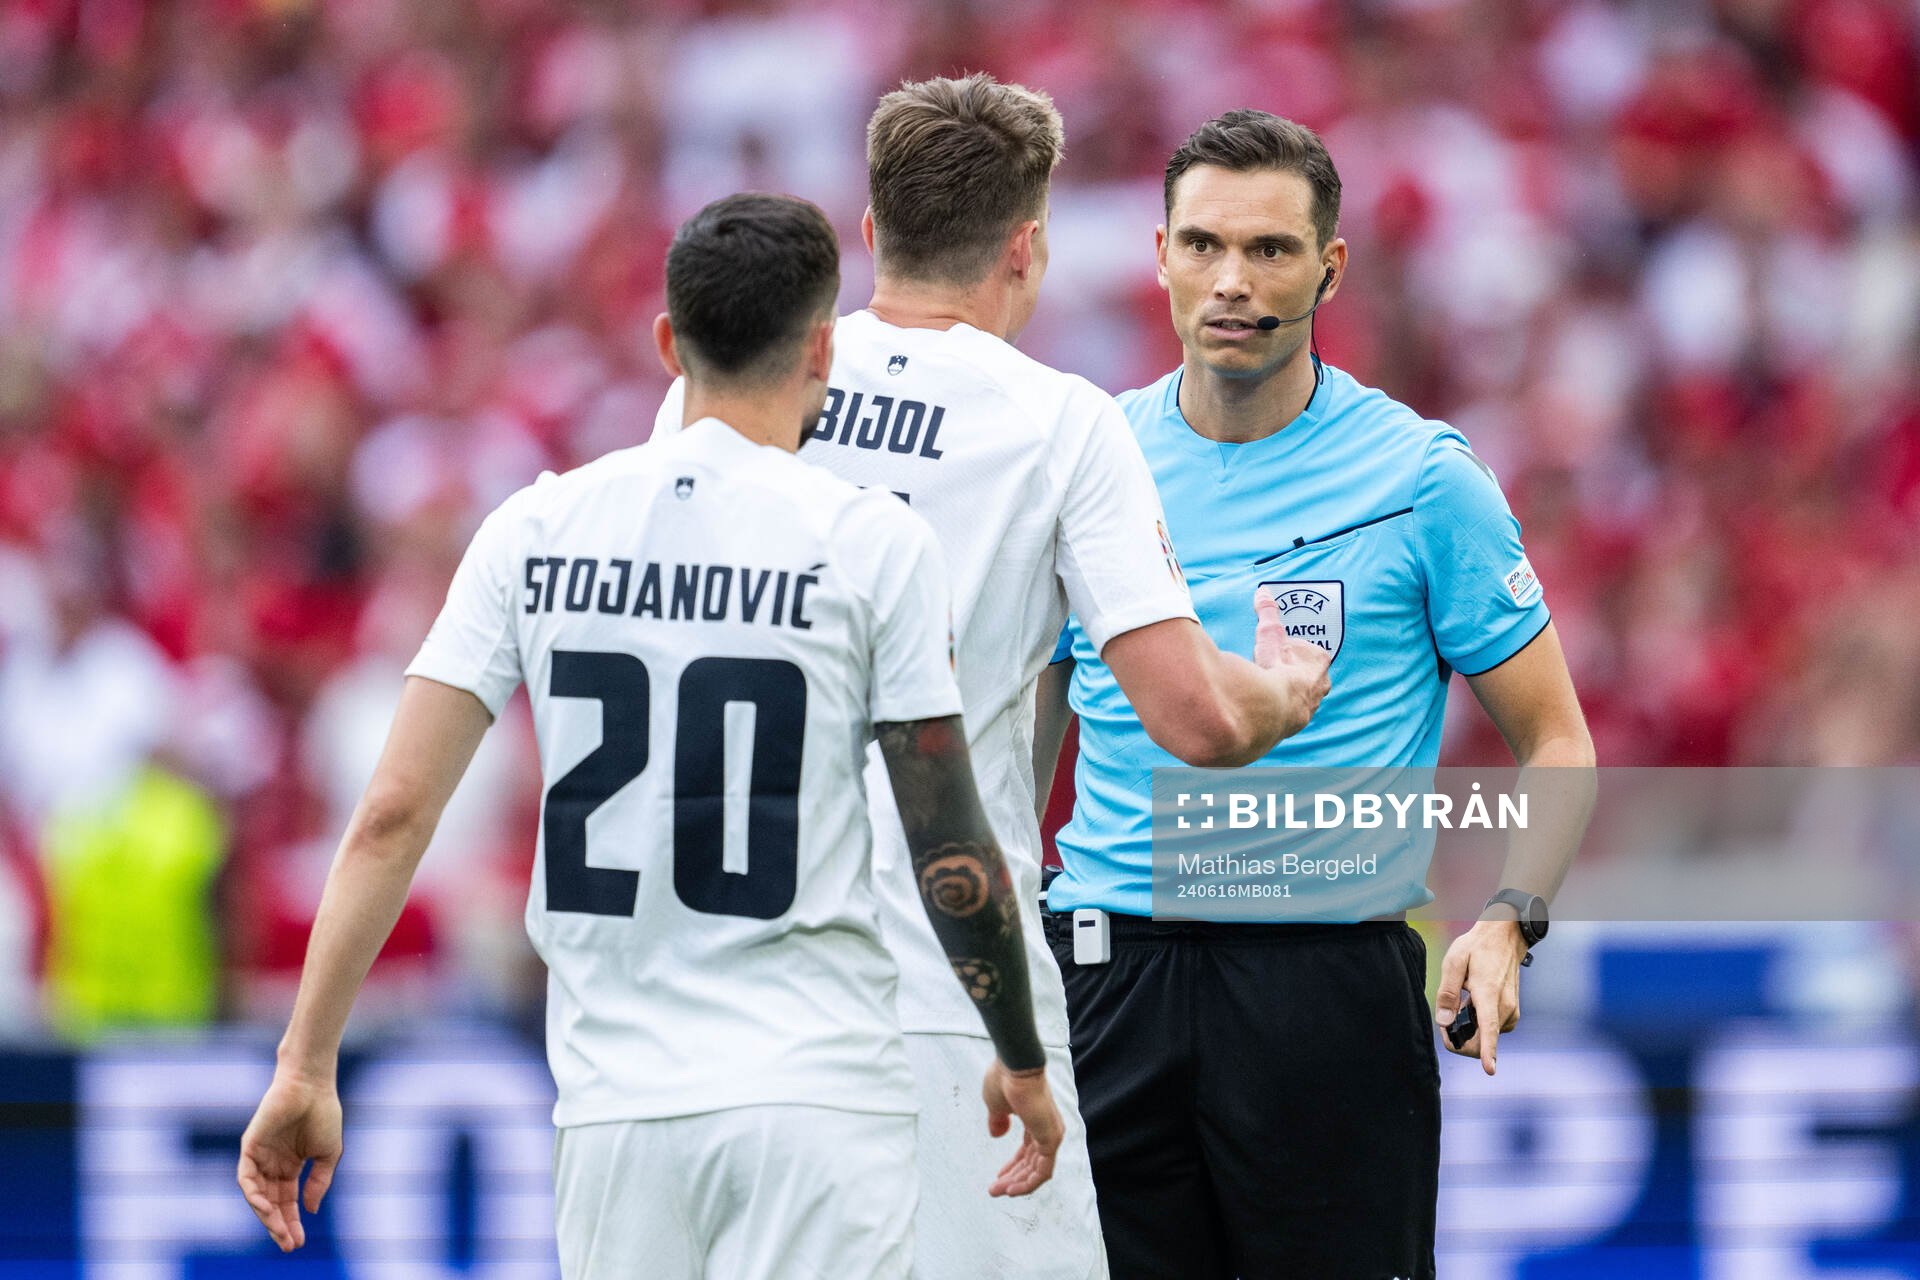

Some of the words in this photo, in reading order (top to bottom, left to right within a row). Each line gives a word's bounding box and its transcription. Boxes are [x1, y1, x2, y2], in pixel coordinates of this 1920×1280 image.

[812, 386, 946, 460] BIJOL
[524, 556, 828, 631] STOJANOVIĆ
[543, 649, 808, 920] 20
